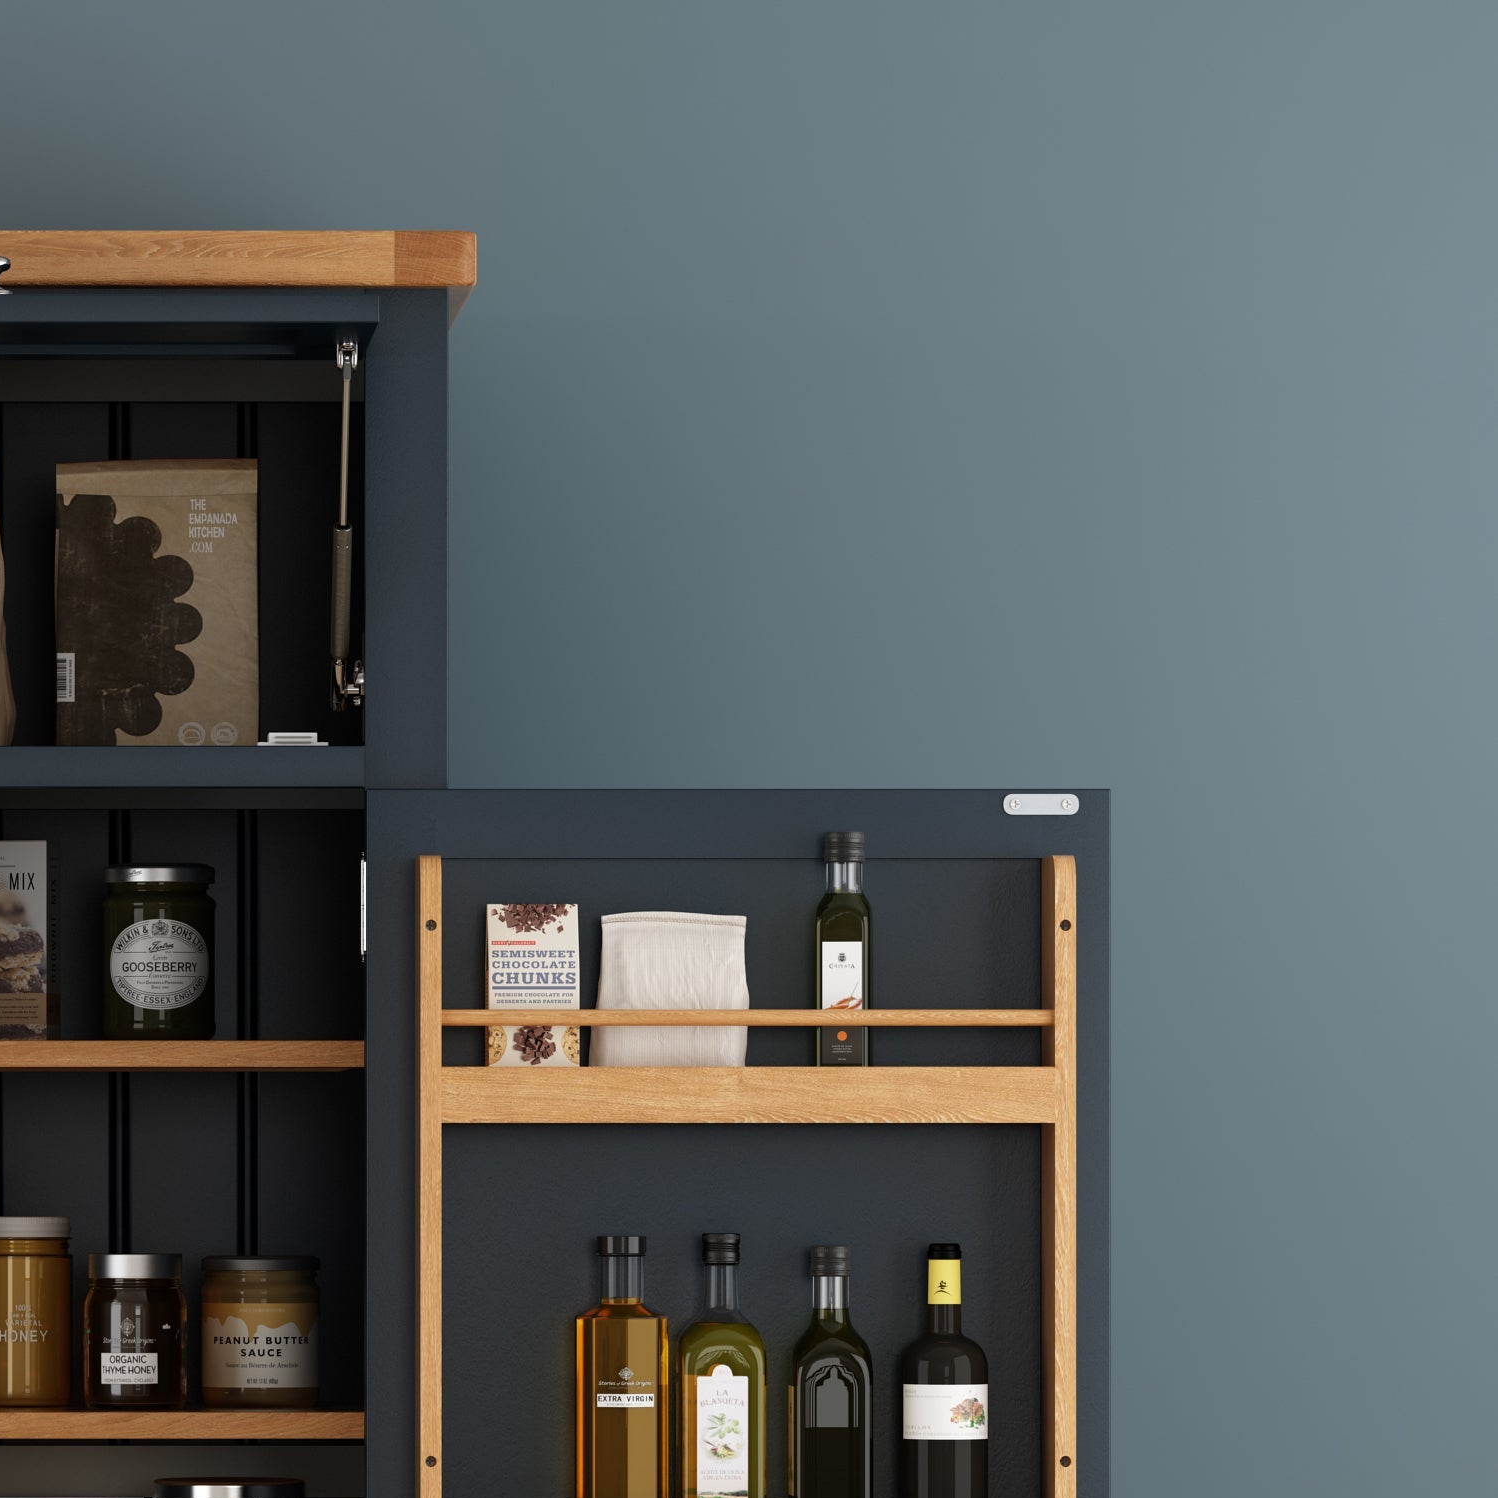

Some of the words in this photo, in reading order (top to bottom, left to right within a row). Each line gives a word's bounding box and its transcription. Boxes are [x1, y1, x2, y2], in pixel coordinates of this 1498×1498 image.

[190, 499, 207, 511] THE
[189, 512, 238, 525] EMPANADA
[189, 527, 225, 538] KITCHEN
[189, 541, 213, 553] .COM
[9, 872, 36, 891] MIX
[115, 927, 141, 951] WILKIN
[142, 926, 149, 934] &
[171, 925, 193, 940] SONS
[192, 938, 205, 952] LTD
[491, 950, 576, 959] SEMISWEET
[122, 961, 198, 972] GOOSEBERRY
[491, 961, 577, 969] CHOCOLATE
[491, 972, 577, 985] CHUNKS
[115, 977, 142, 1001] TIPTREE
[143, 995, 172, 1005] ESSEX
[174, 977, 205, 1003] ENGLAND
[213, 1336, 259, 1345] PEANUT
[265, 1336, 310, 1345] BUTTER
[240, 1348, 283, 1358] SAUCE
[109, 1355, 147, 1364] ORGANIC
[102, 1365, 127, 1375] THYME
[128, 1365, 157, 1375] HONEY
[716, 1389, 729, 1397] LA
